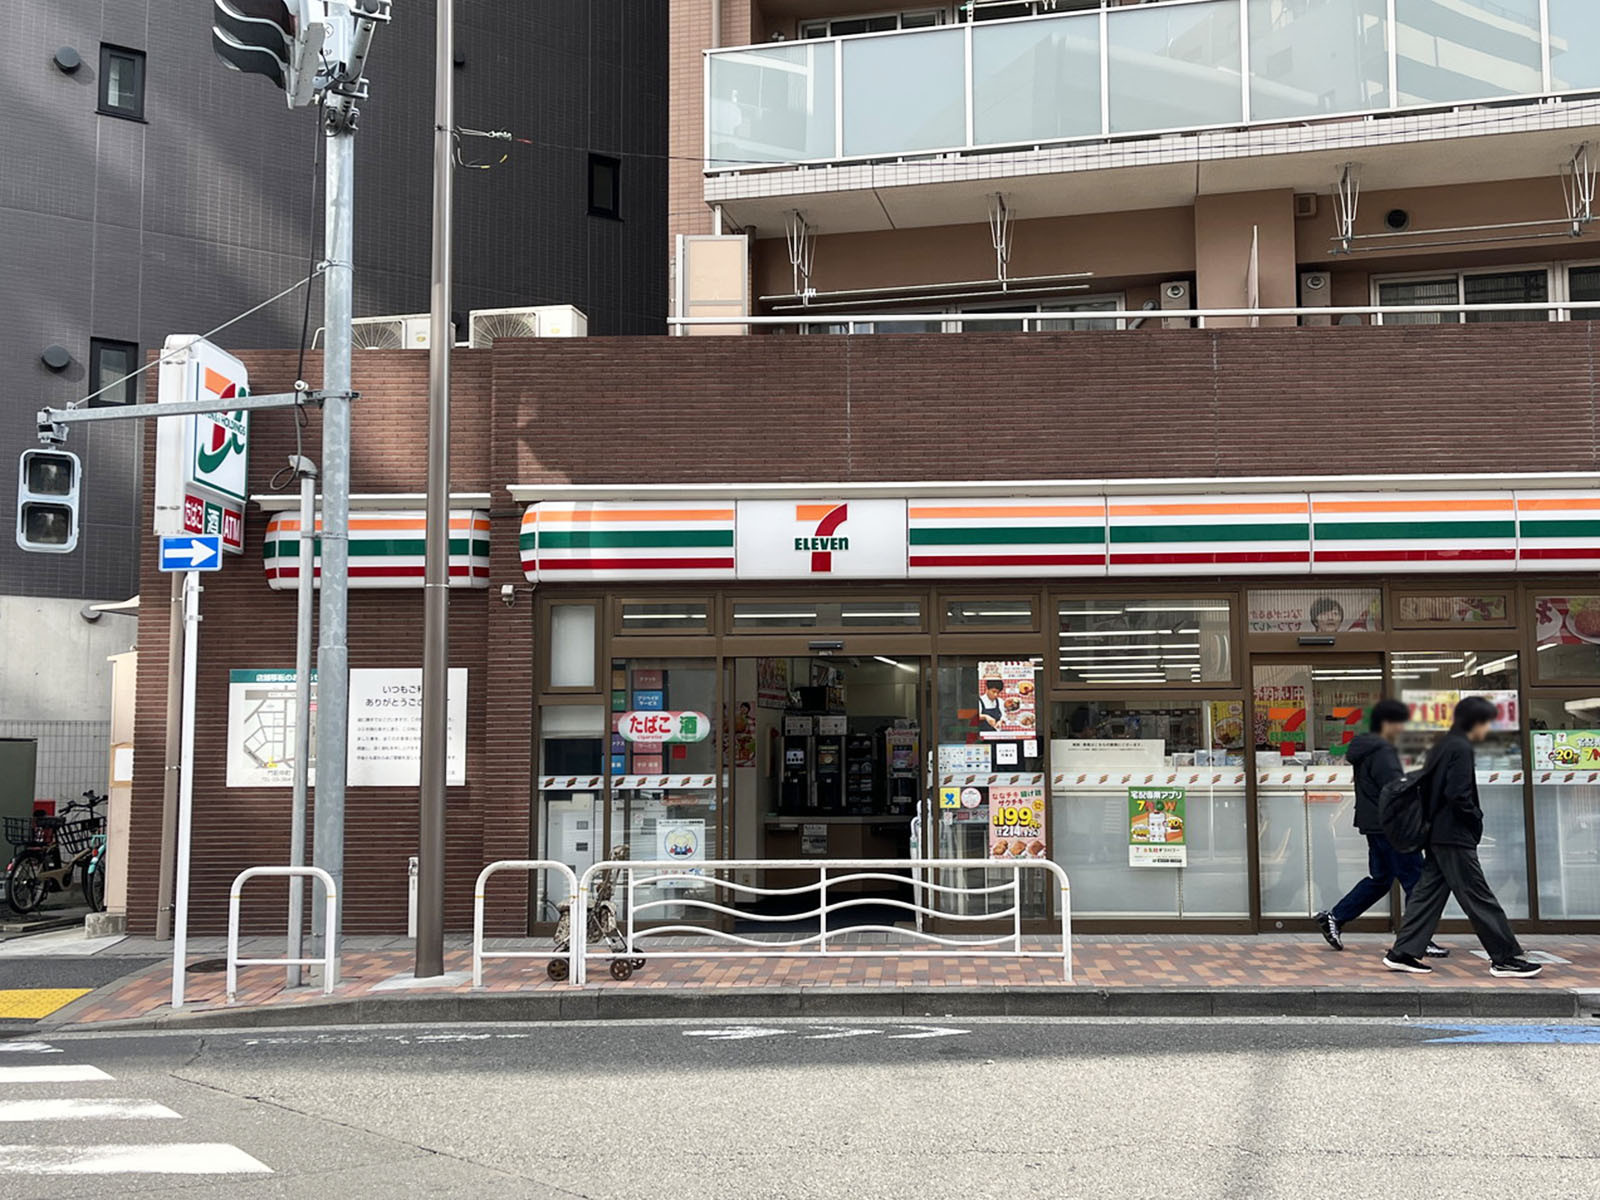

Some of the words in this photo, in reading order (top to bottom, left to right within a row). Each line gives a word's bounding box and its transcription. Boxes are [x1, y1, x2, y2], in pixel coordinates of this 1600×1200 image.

[224, 515, 241, 542] ATM
[629, 715, 671, 734] たばこ
[679, 715, 697, 734] 酒
